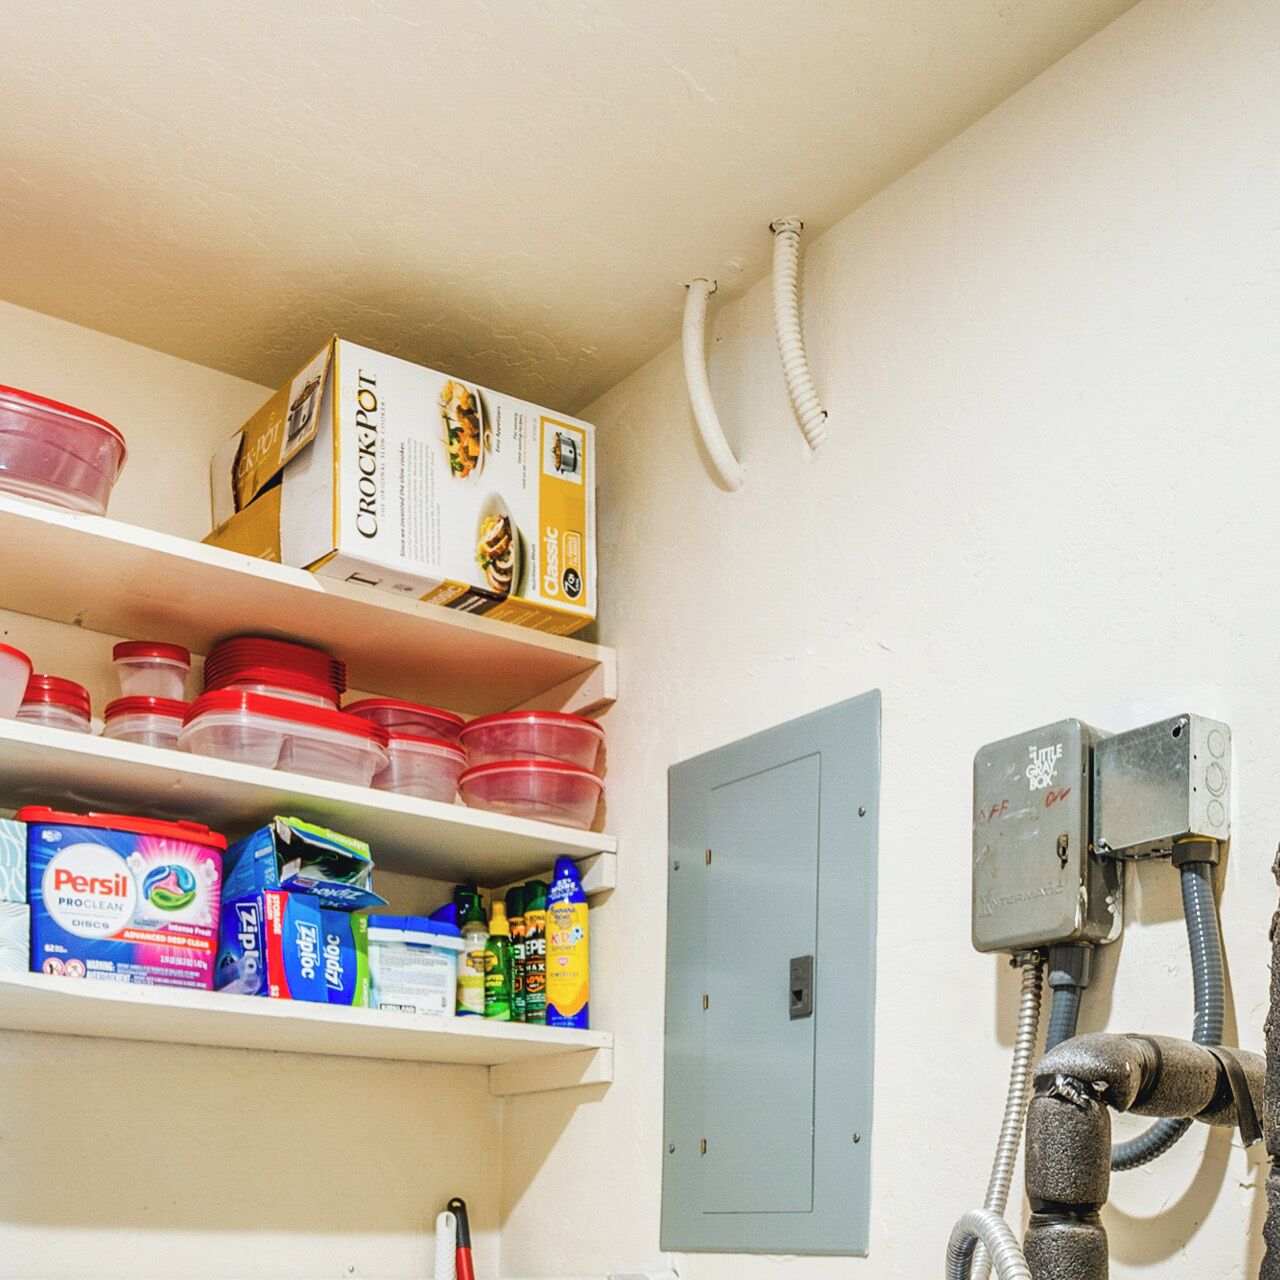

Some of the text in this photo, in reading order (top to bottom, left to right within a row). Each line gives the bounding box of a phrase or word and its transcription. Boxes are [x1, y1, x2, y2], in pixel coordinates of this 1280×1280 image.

[544, 526, 559, 596] Classic
[1029, 773, 1054, 791] BOX
[54, 868, 128, 898] Persil
[308, 886, 363, 900] Ziploc
[57, 896, 124, 911] PROCLEAN
[71, 919, 110, 930] DISCS
[123, 930, 167, 942] ADVANCED
[295, 926, 317, 980] Ziploc
[322, 934, 345, 986] Ziploc
